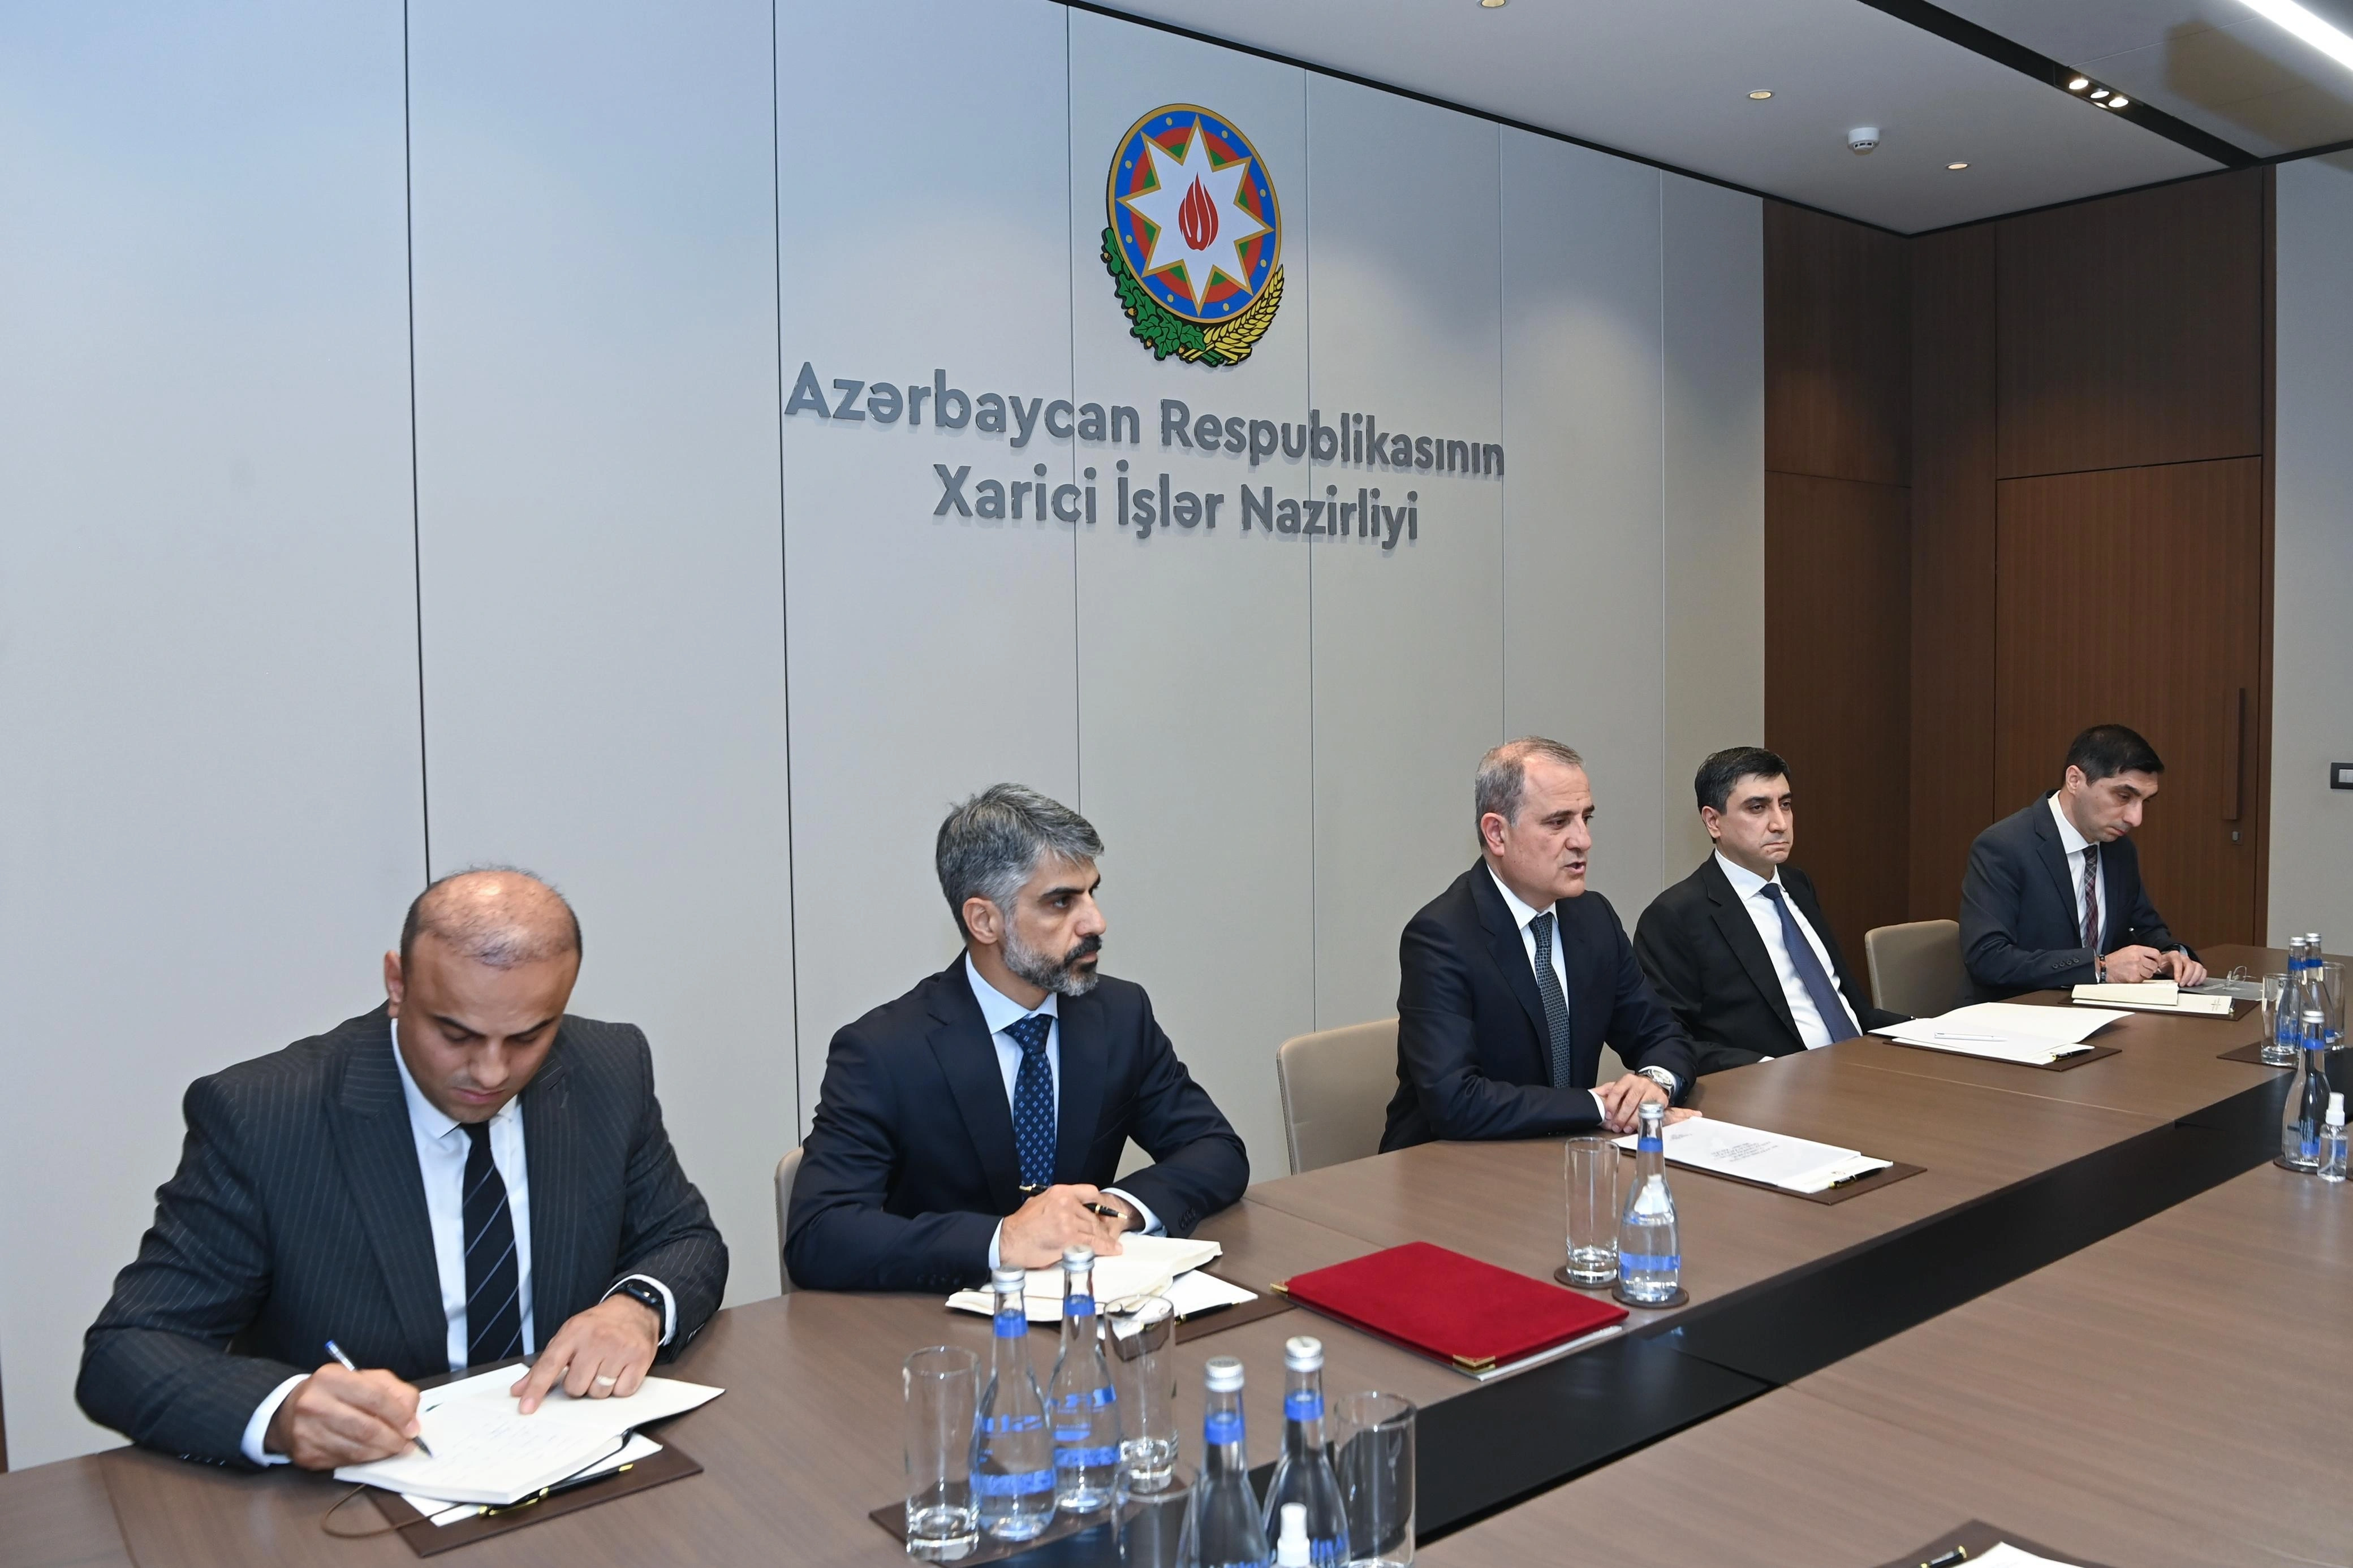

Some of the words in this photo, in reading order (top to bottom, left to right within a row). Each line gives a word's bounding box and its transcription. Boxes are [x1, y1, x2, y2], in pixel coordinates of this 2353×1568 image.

[785, 361, 1140, 447] Azərbaycan
[1161, 399, 1505, 475] Respublikasının
[933, 463, 1097, 524] Xarici
[1116, 459, 1225, 538] İşlər
[1240, 484, 1417, 550] Nazirliyi
